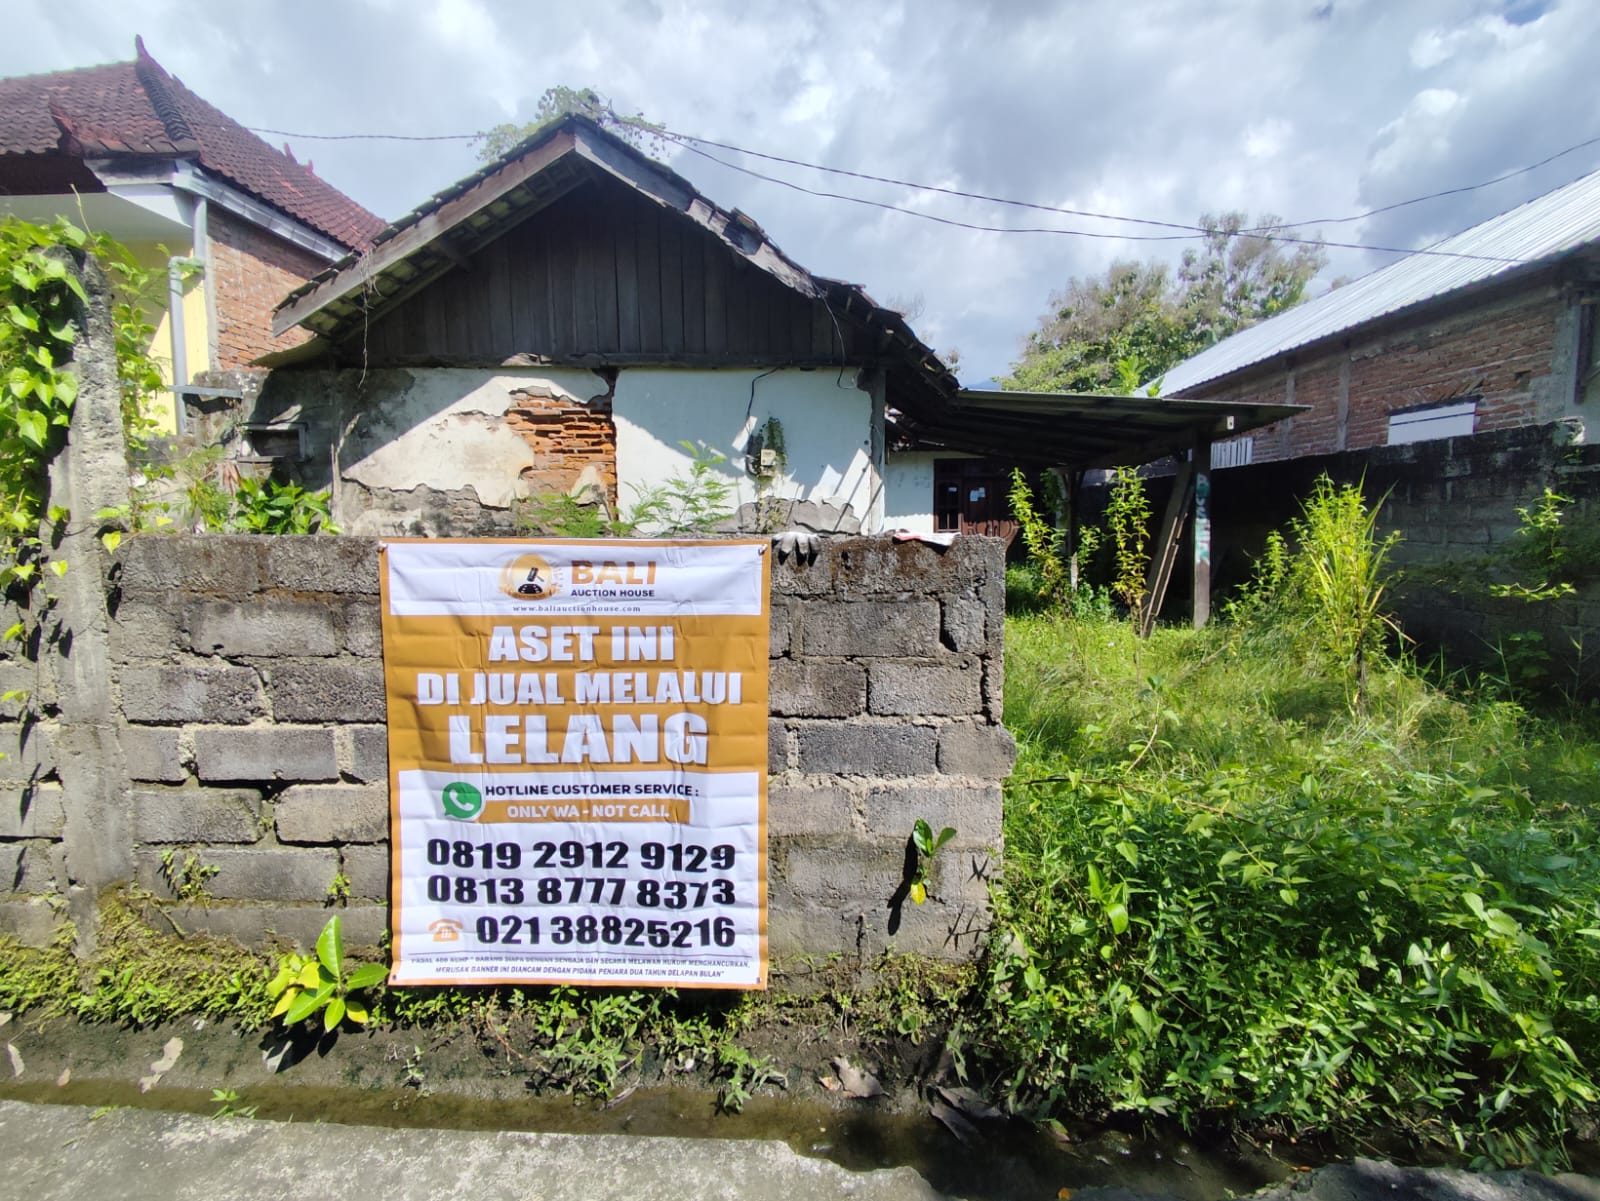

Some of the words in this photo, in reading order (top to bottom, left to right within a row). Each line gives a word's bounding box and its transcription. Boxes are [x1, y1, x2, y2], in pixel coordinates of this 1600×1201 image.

[571, 560, 657, 584] BALI
[571, 589, 617, 597] AUCTION
[619, 589, 655, 597] HOUSE
[512, 605, 641, 613] www.baliauctionhouse.com
[488, 625, 600, 662] ASET
[611, 625, 674, 661] INI
[417, 673, 460, 705] DI
[470, 672, 565, 705] JUAL
[575, 671, 741, 705] MELALUI
[448, 712, 708, 765] LELANG
[486, 785, 549, 796] HOTLINE
[552, 784, 631, 795] CUSTOMER
[634, 784, 692, 796] SERVICE
[507, 805, 550, 818] ONLY
[553, 805, 580, 817] WA
[592, 804, 626, 817] NOT
[629, 805, 670, 817] CALL
[427, 838, 522, 870] 0819
[532, 841, 629, 868] 2912
[640, 842, 736, 872] 9129
[427, 874, 524, 904] 0813
[537, 877, 626, 905] 8777
[636, 878, 736, 909] 8373
[476, 915, 540, 944] 021
[550, 915, 736, 948] 38825216
[543, 966, 571, 974] DENGAN
[645, 968, 667, 976] TAHUN
[667, 969, 698, 977] DELAPAN
